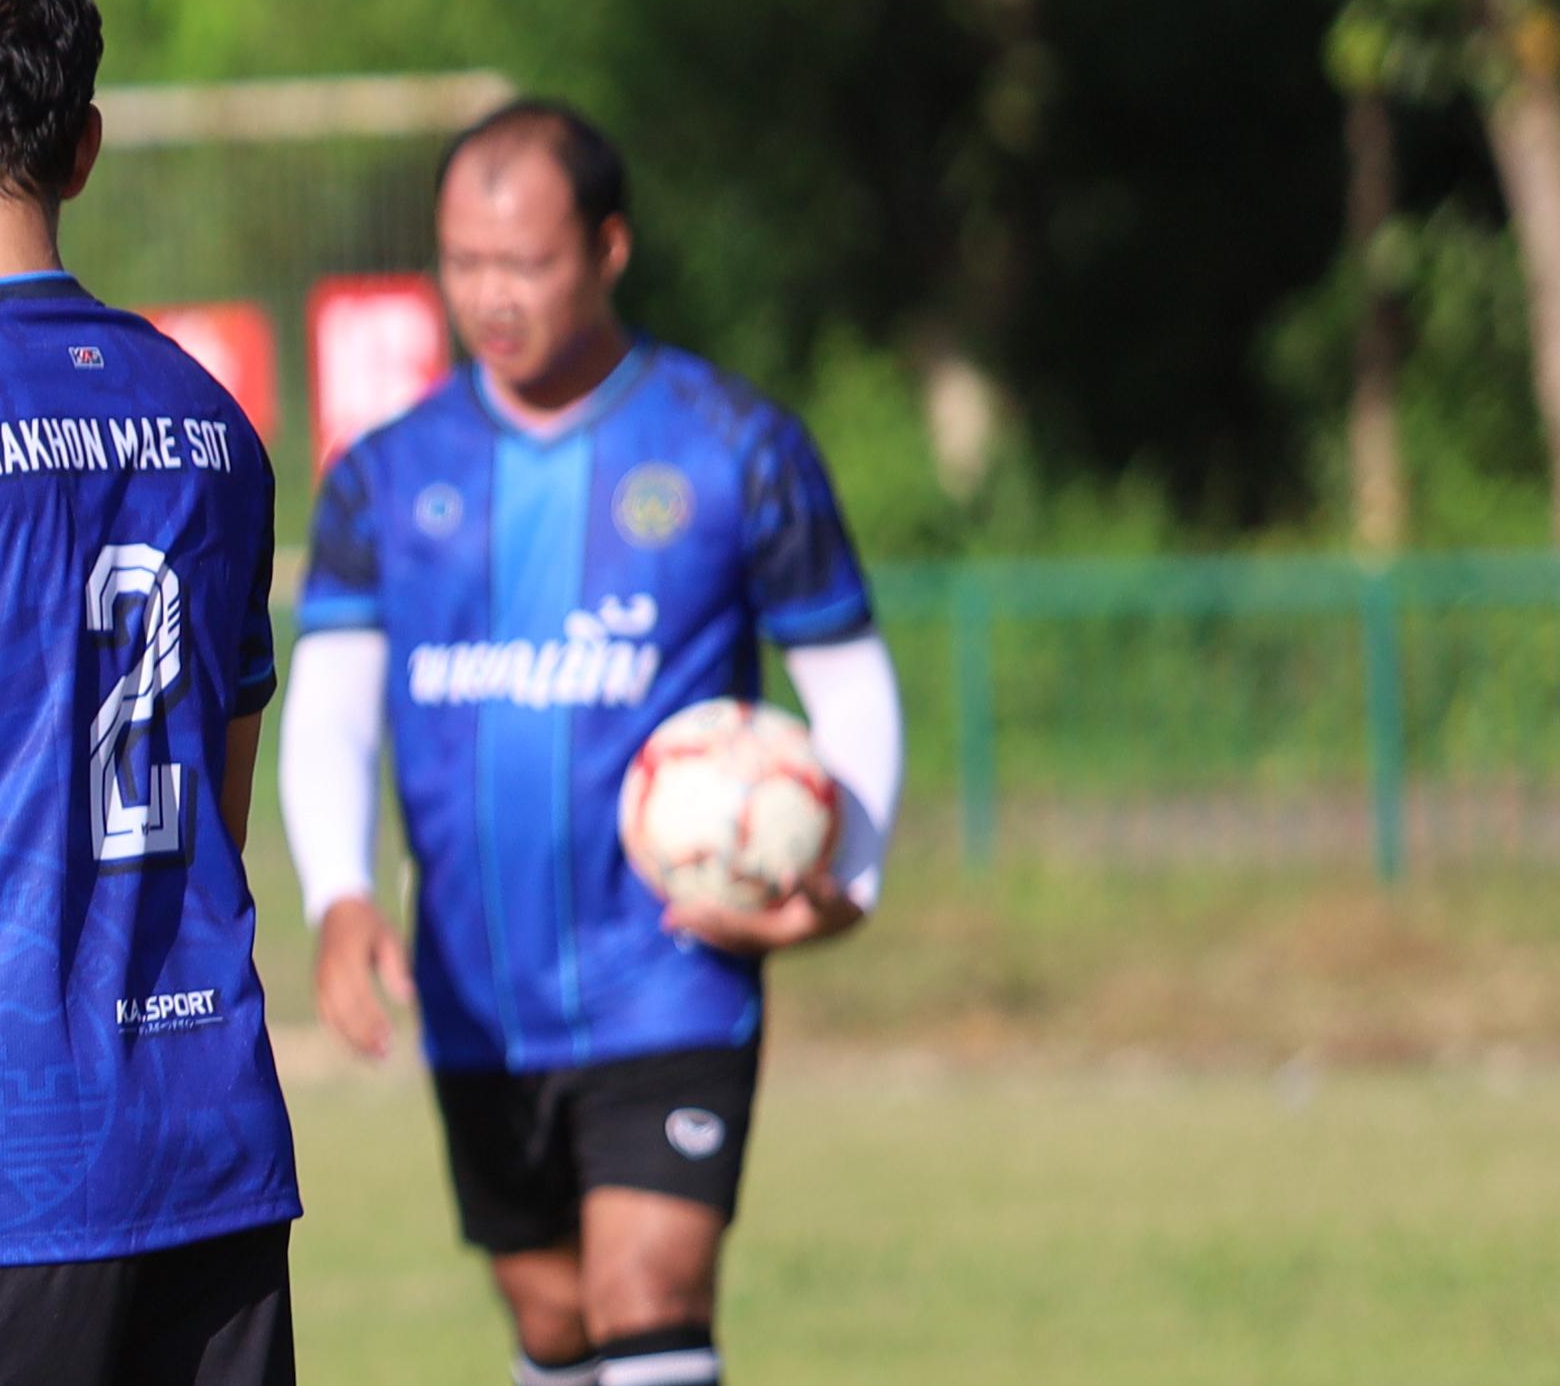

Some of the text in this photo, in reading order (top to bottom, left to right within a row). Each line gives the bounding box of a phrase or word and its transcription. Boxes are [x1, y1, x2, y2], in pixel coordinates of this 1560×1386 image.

[108, 416, 181, 471] MAE
[183, 417, 231, 474] SOT
[86, 542, 183, 861] 2
